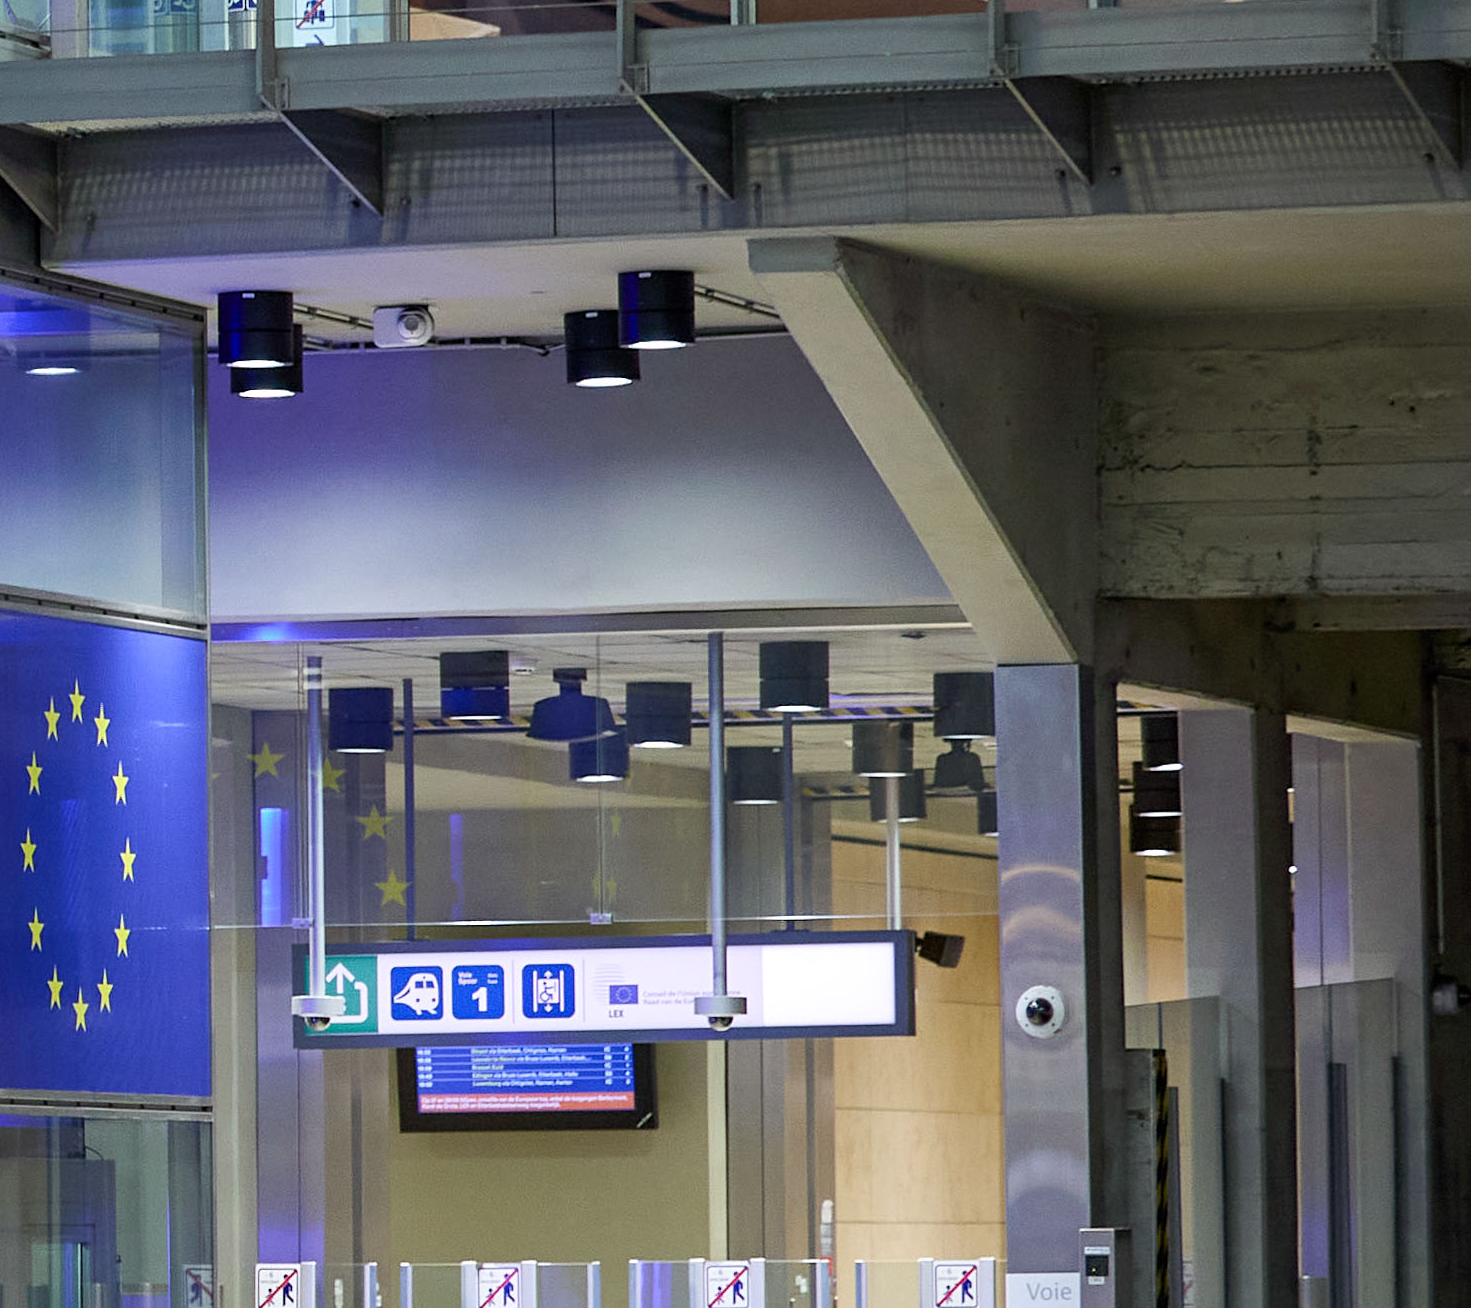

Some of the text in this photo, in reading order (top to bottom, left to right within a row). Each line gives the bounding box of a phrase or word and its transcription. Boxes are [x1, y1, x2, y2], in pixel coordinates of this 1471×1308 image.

[471, 986, 488, 1012] 1
[608, 1009, 624, 1018] LEX
[1026, 1282, 1072, 1301] Voie
